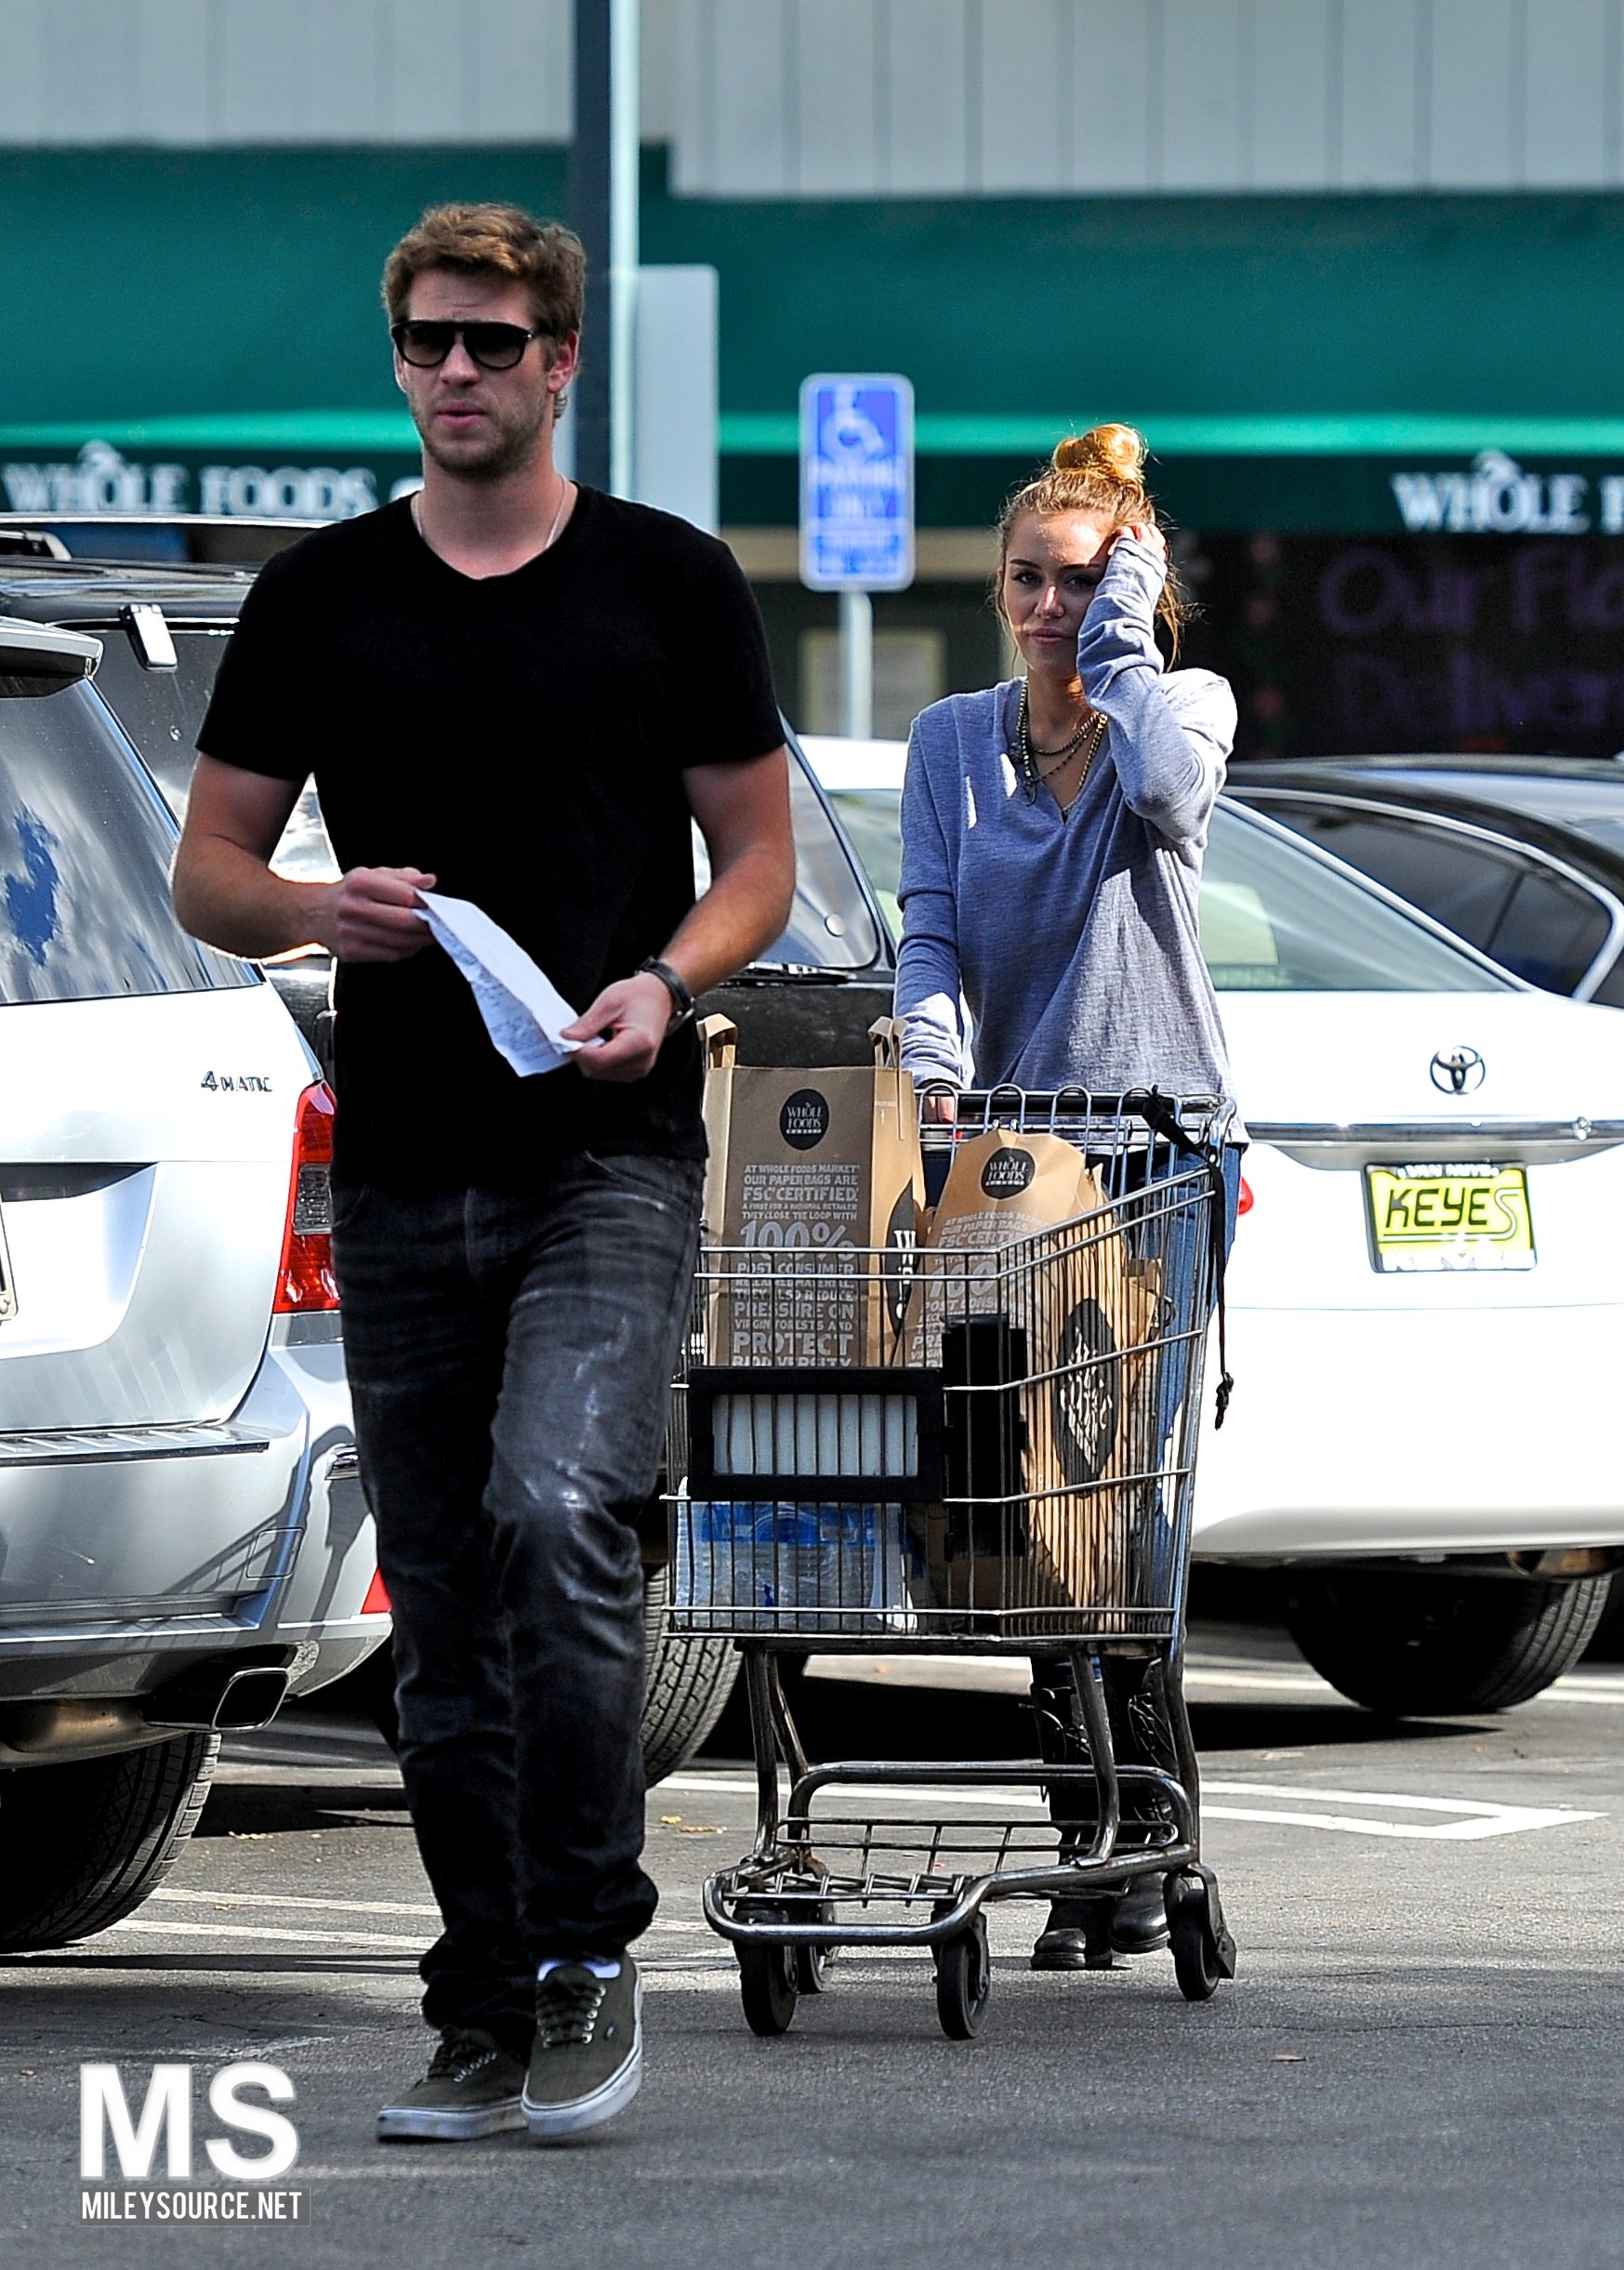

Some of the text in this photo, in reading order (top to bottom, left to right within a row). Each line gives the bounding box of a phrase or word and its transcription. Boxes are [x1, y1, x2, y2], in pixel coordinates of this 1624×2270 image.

[3, 455, 188, 513] WHOLE
[198, 466, 377, 518] FOODS
[1390, 463, 1591, 535] WHOLE
[787, 1105, 824, 1118] WHOLE
[788, 1117, 822, 1129] FOODS
[744, 1164, 758, 1174] AT
[758, 1164, 790, 1174] WHOLE
[744, 1175, 858, 1185] OUR PAPER BAGS ARE
[764, 1210, 790, 1220] CLOSE
[809, 1210, 831, 1220] LOOP
[833, 1210, 857, 1220] WITH
[1385, 1186, 1525, 1240] KEYES
[740, 1220, 856, 1261] 100%
[733, 1331, 853, 1356] PROTECT
